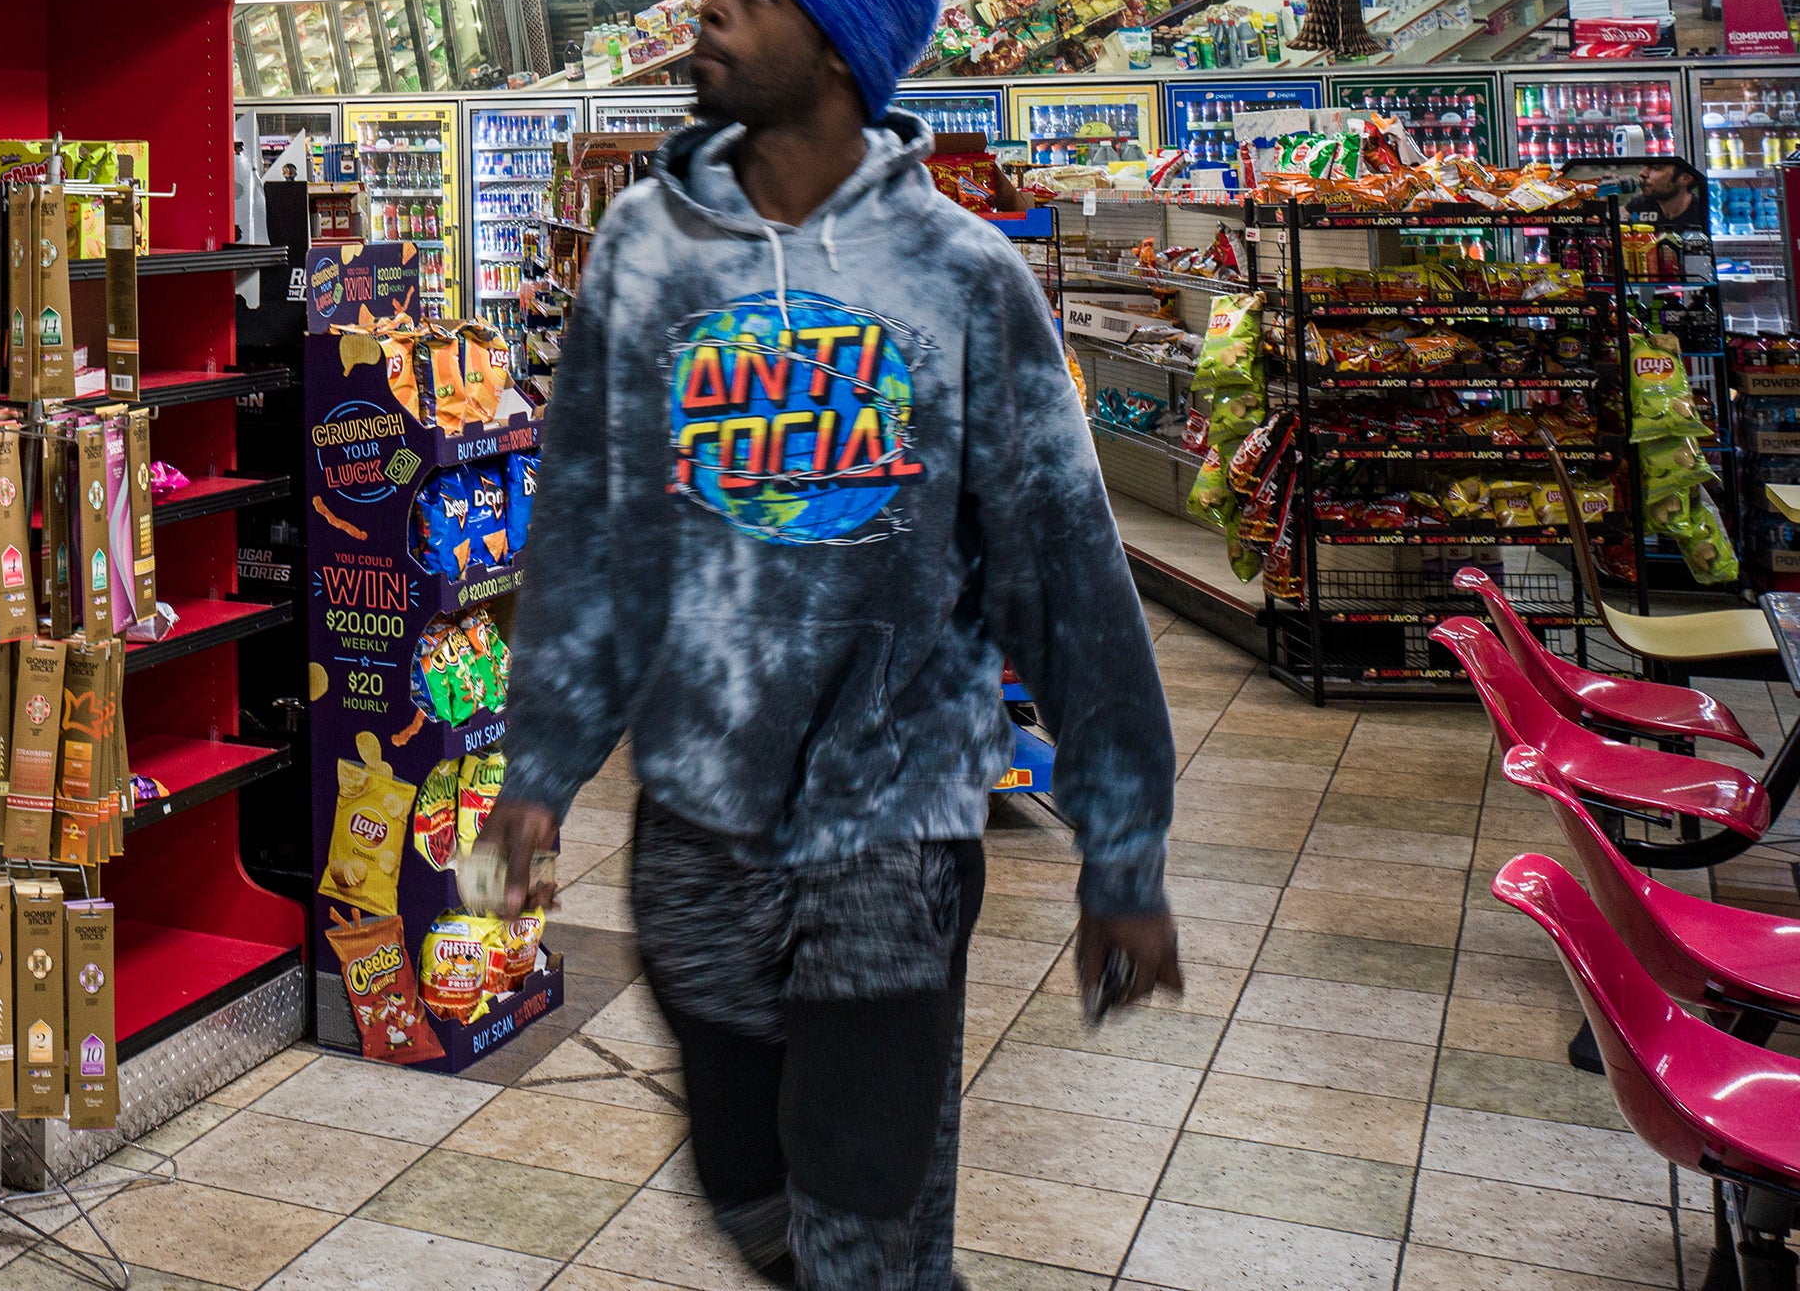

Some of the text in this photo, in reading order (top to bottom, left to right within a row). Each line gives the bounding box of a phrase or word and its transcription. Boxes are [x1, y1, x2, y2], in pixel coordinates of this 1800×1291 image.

[1215, 92, 1234, 100] pepsi
[1277, 91, 1296, 99] pepsi
[1333, 215, 1402, 225] SAVOR FLAVOR
[1423, 215, 1492, 225] SAVOR FLAVOR
[1513, 215, 1583, 224] SAVOR FLAVOR
[344, 276, 373, 301] WIN
[1069, 310, 1092, 324] RAP
[1329, 306, 1398, 315] SAVOR FLAVOR
[43, 317, 58, 333] 14
[681, 324, 882, 410] ANTI
[1636, 356, 1674, 375] Lay's
[1752, 378, 1800, 388] POWER
[312, 413, 405, 447] CRUNCH
[343, 442, 381, 459] YOUR
[458, 441, 476, 461] BUY.
[665, 406, 924, 495] SOCIAL
[325, 459, 385, 489] LUCK
[335, 553, 393, 568] YOU COULD
[323, 566, 407, 611] WIN
[469, 579, 497, 601] $20,000
[326, 608, 404, 638] $20,000
[341, 636, 389, 653] WEEKLY
[26, 656, 58, 667] GONESH
[30, 665, 54, 673] STICKS
[348, 671, 383, 696] $20
[343, 696, 389, 714] HOURLY
[465, 732, 483, 752] BUY.
[351, 814, 387, 841] Lay's
[352, 848, 377, 862] Classic
[23, 910, 57, 920] GONESH
[28, 917, 53, 926] STICKS
[75, 926, 107, 936] GONESH
[80, 933, 104, 941] STICKS
[349, 943, 402, 993] Cheetos
[448, 979, 476, 988] FRIES
[35, 1032, 46, 1048] 2
[473, 1032, 490, 1053] BUY.
[85, 1047, 102, 1063] 10
